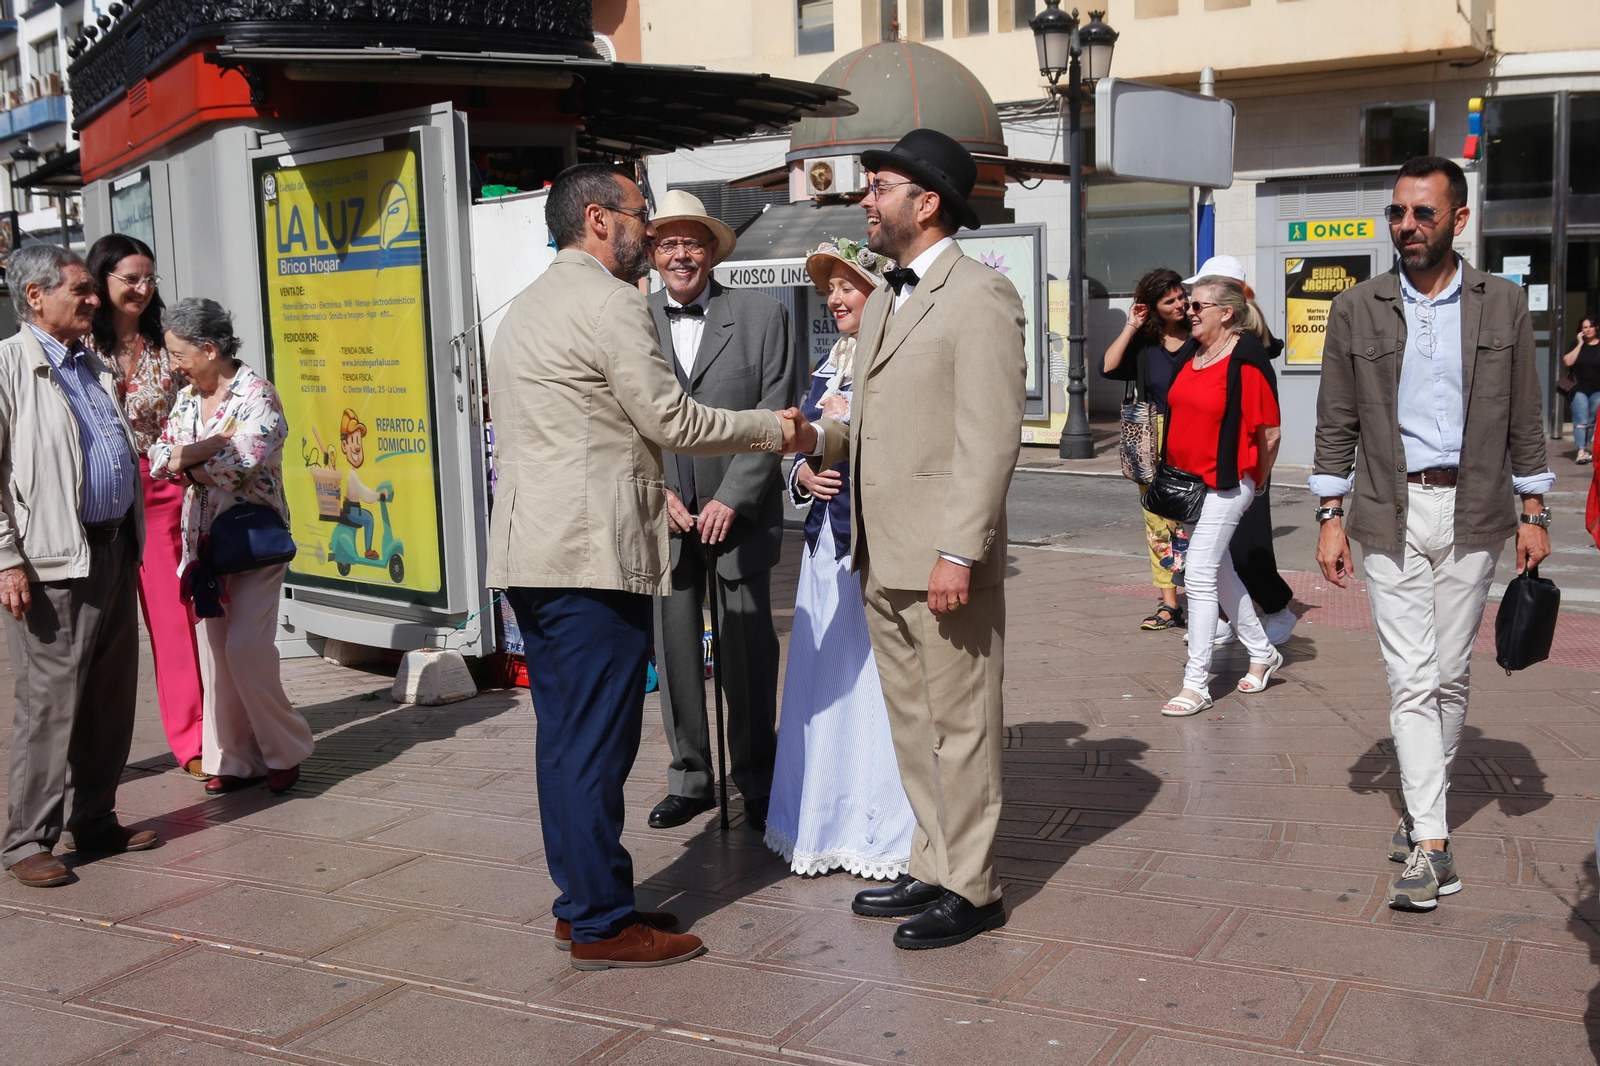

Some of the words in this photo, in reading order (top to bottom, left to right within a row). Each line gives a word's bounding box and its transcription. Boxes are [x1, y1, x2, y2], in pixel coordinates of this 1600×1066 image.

[297, 181, 305, 190] de
[275, 203, 308, 254] LA
[313, 197, 368, 251] LUZ
[1314, 222, 1367, 237] ONCE
[280, 259, 307, 275] Brico
[309, 257, 340, 276] Hogar
[730, 268, 775, 285] KIOSCO
[280, 287, 296, 297] VENTA
[296, 286, 305, 296] DE:
[1292, 324, 1327, 333] 120.00
[284, 333, 305, 342] PEDIDOS
[305, 332, 319, 342] POR:
[816, 338, 830, 346] Tlf.
[341, 346, 358, 355] TIENDA
[342, 373, 358, 381] TIENDA
[348, 385, 363, 393] Doctor
[376, 417, 414, 433] REPARTO
[417, 418, 426, 433] A
[378, 437, 426, 453] DOMICILIO
